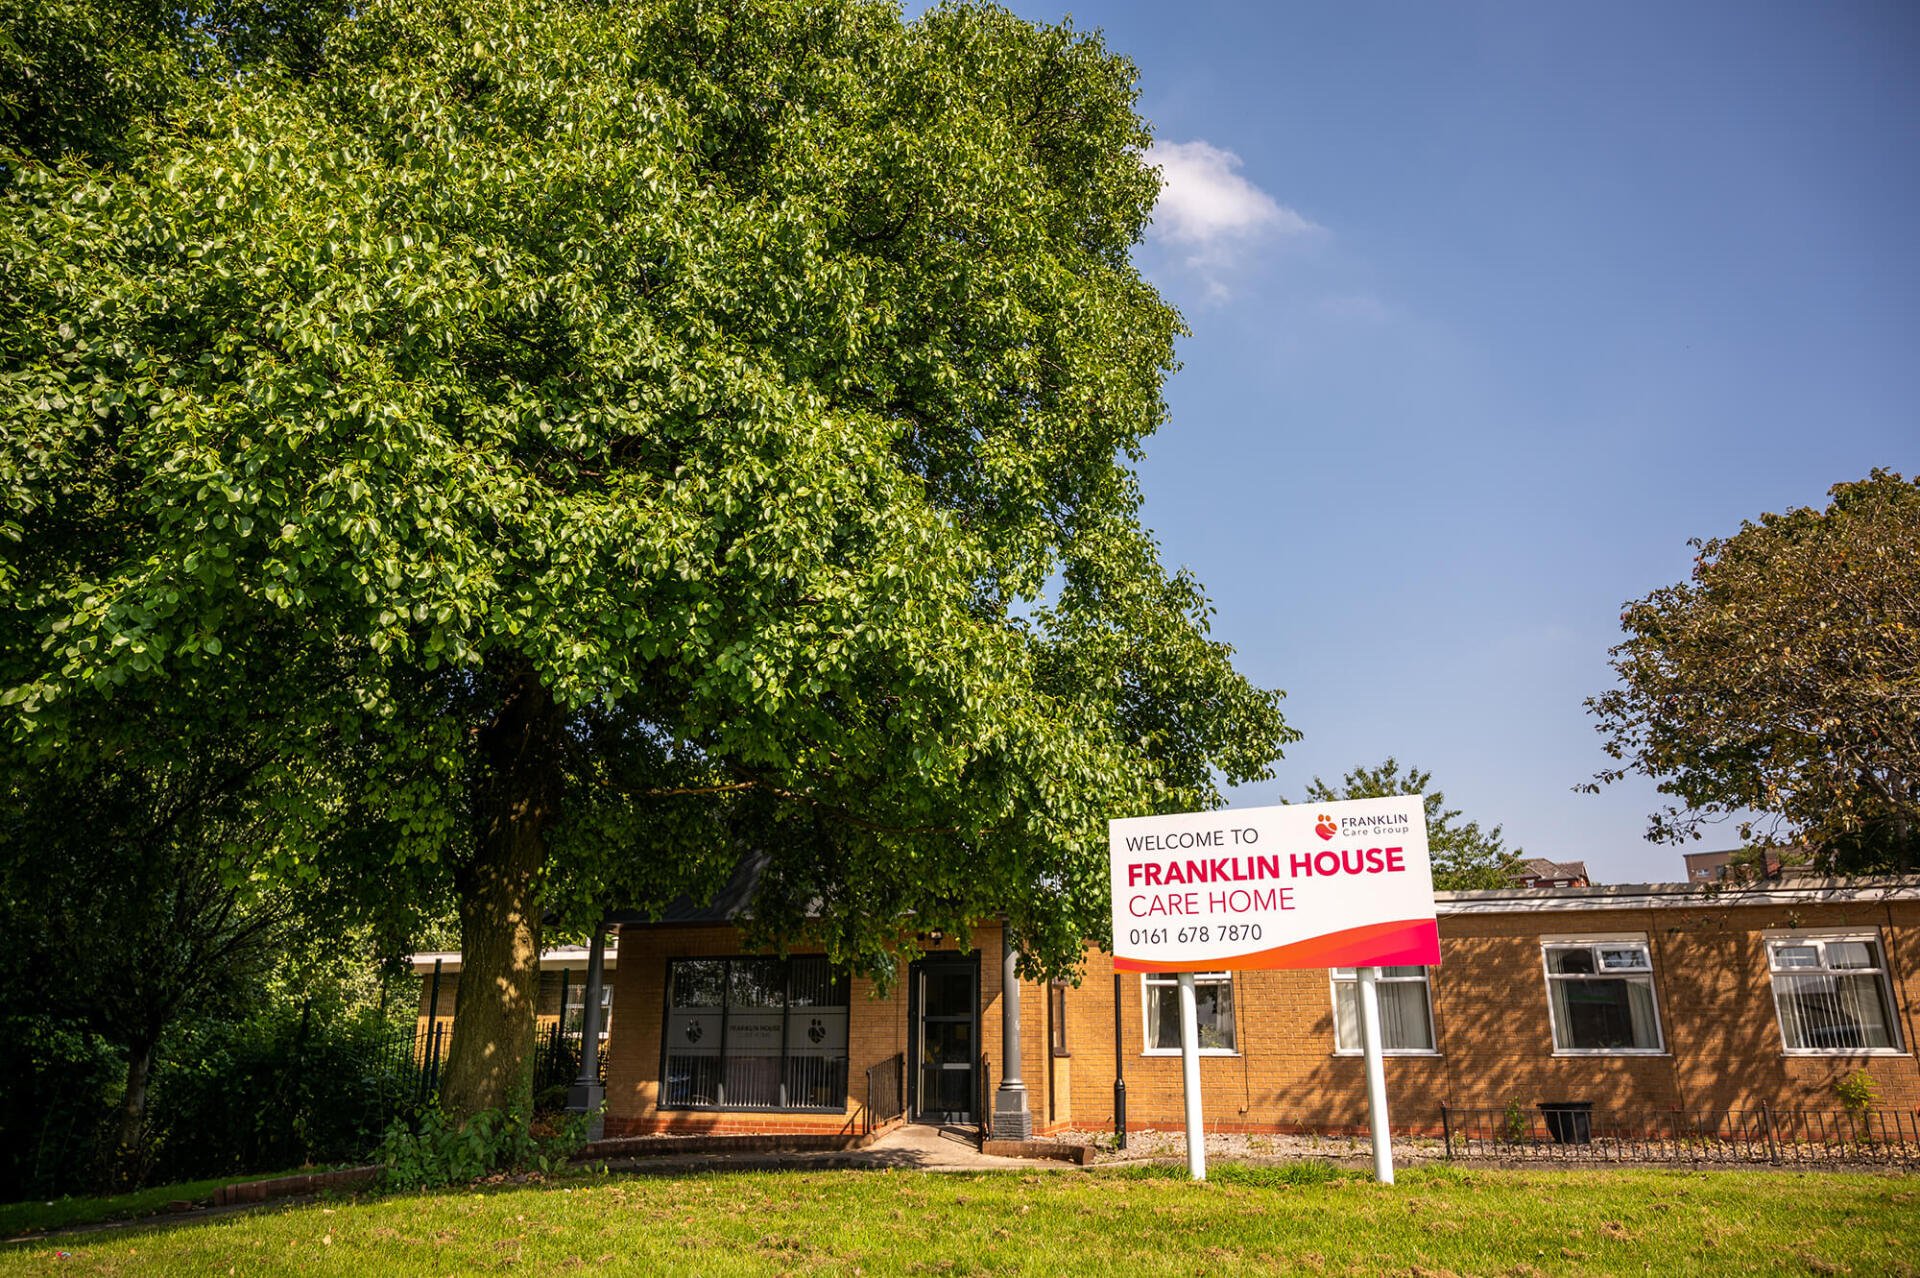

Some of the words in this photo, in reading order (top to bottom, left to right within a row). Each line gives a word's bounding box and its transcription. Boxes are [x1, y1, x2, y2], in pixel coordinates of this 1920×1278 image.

[1342, 814, 1408, 828] FRANKLIN
[1343, 827, 1368, 836] Care
[1374, 824, 1409, 835] Group
[1126, 830, 1224, 852] WELCOME
[1231, 828, 1258, 844] TO
[1128, 855, 1280, 887] FRANKLIN
[1290, 847, 1406, 878] HOUSE
[1129, 893, 1199, 917] CARE
[1209, 887, 1295, 913] HOME
[1130, 928, 1167, 945] 0161
[1178, 926, 1209, 943] 678
[1218, 924, 1262, 941] 7870
